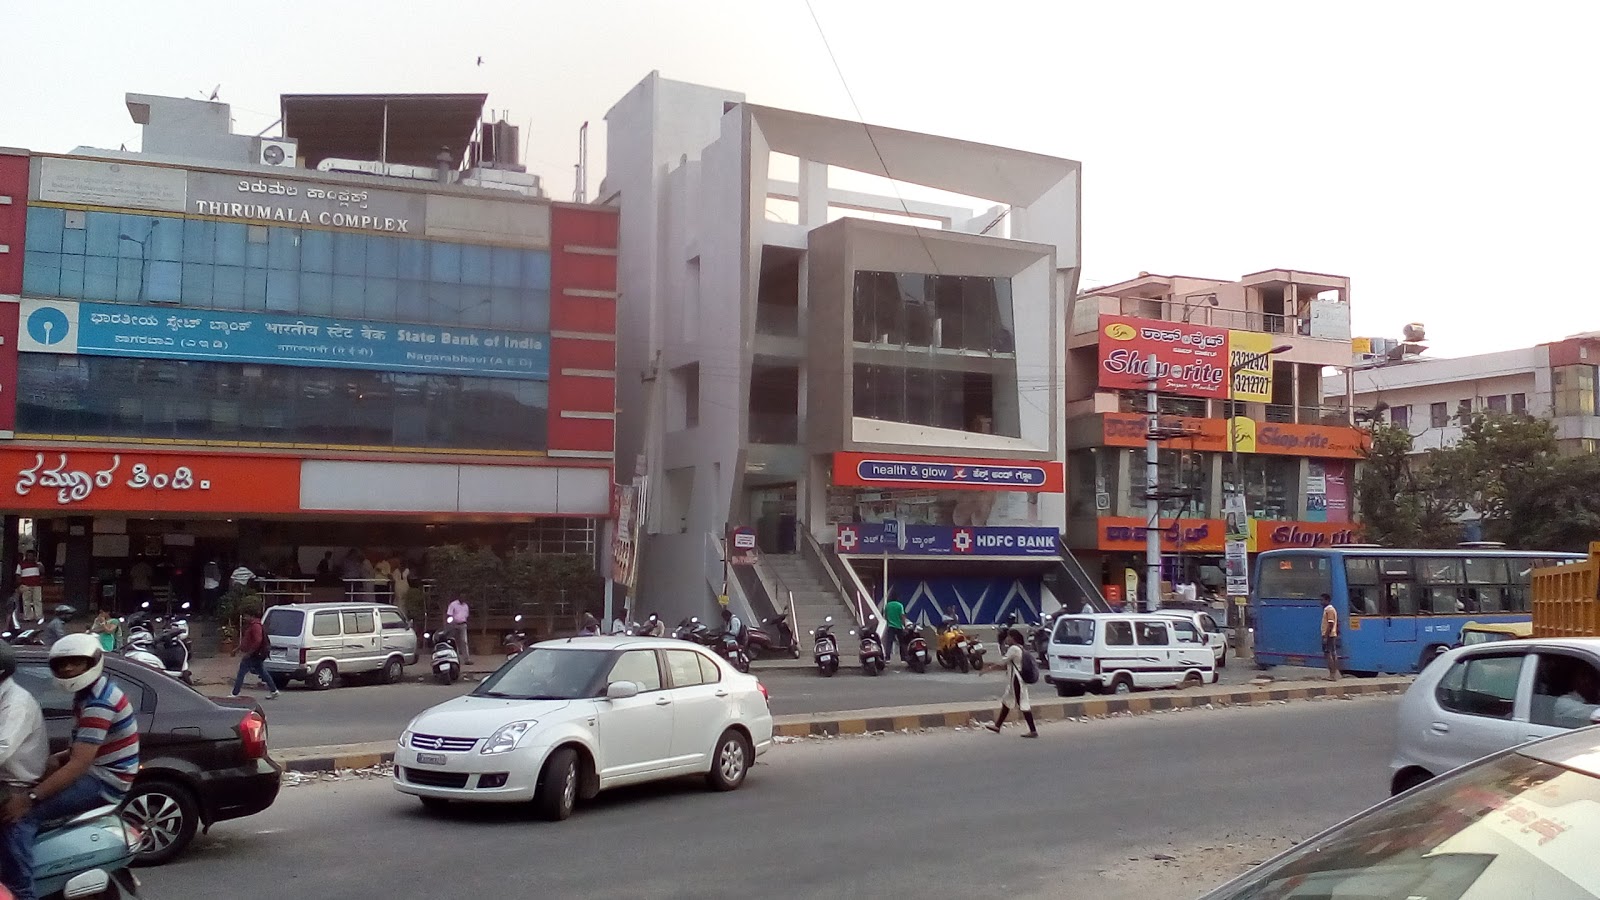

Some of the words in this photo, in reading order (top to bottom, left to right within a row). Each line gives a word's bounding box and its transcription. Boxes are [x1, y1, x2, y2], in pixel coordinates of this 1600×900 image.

[195, 200, 311, 224] THIRUMALA
[319, 211, 409, 233] COMPLEX
[91, 313, 158, 327] ಭಾರತೀಯ
[209, 320, 252, 335] ಬ್ಯಾಂಕ್
[265, 321, 319, 337] भारतीय
[326, 323, 354, 339] स्टेट
[361, 325, 386, 340] बैंक
[397, 329, 435, 344] State
[441, 332, 479, 347] Bank
[484, 335, 499, 348] of
[504, 336, 543, 350] India
[406, 351, 486, 363] Nagarabhavi
[1182, 359, 1224, 383] rite
[1232, 374, 1270, 395] 3212727
[1258, 426, 1299, 451] Shop
[1302, 432, 1329, 449] rite
[15, 453, 121, 504] ನಮ್ಮೂರ
[872, 464, 907, 477] health
[910, 465, 919, 477] &
[922, 466, 947, 478] glow
[976, 534, 1014, 547] HDFC
[1017, 535, 1056, 548] BANK
[1270, 525, 1325, 547] Shop
